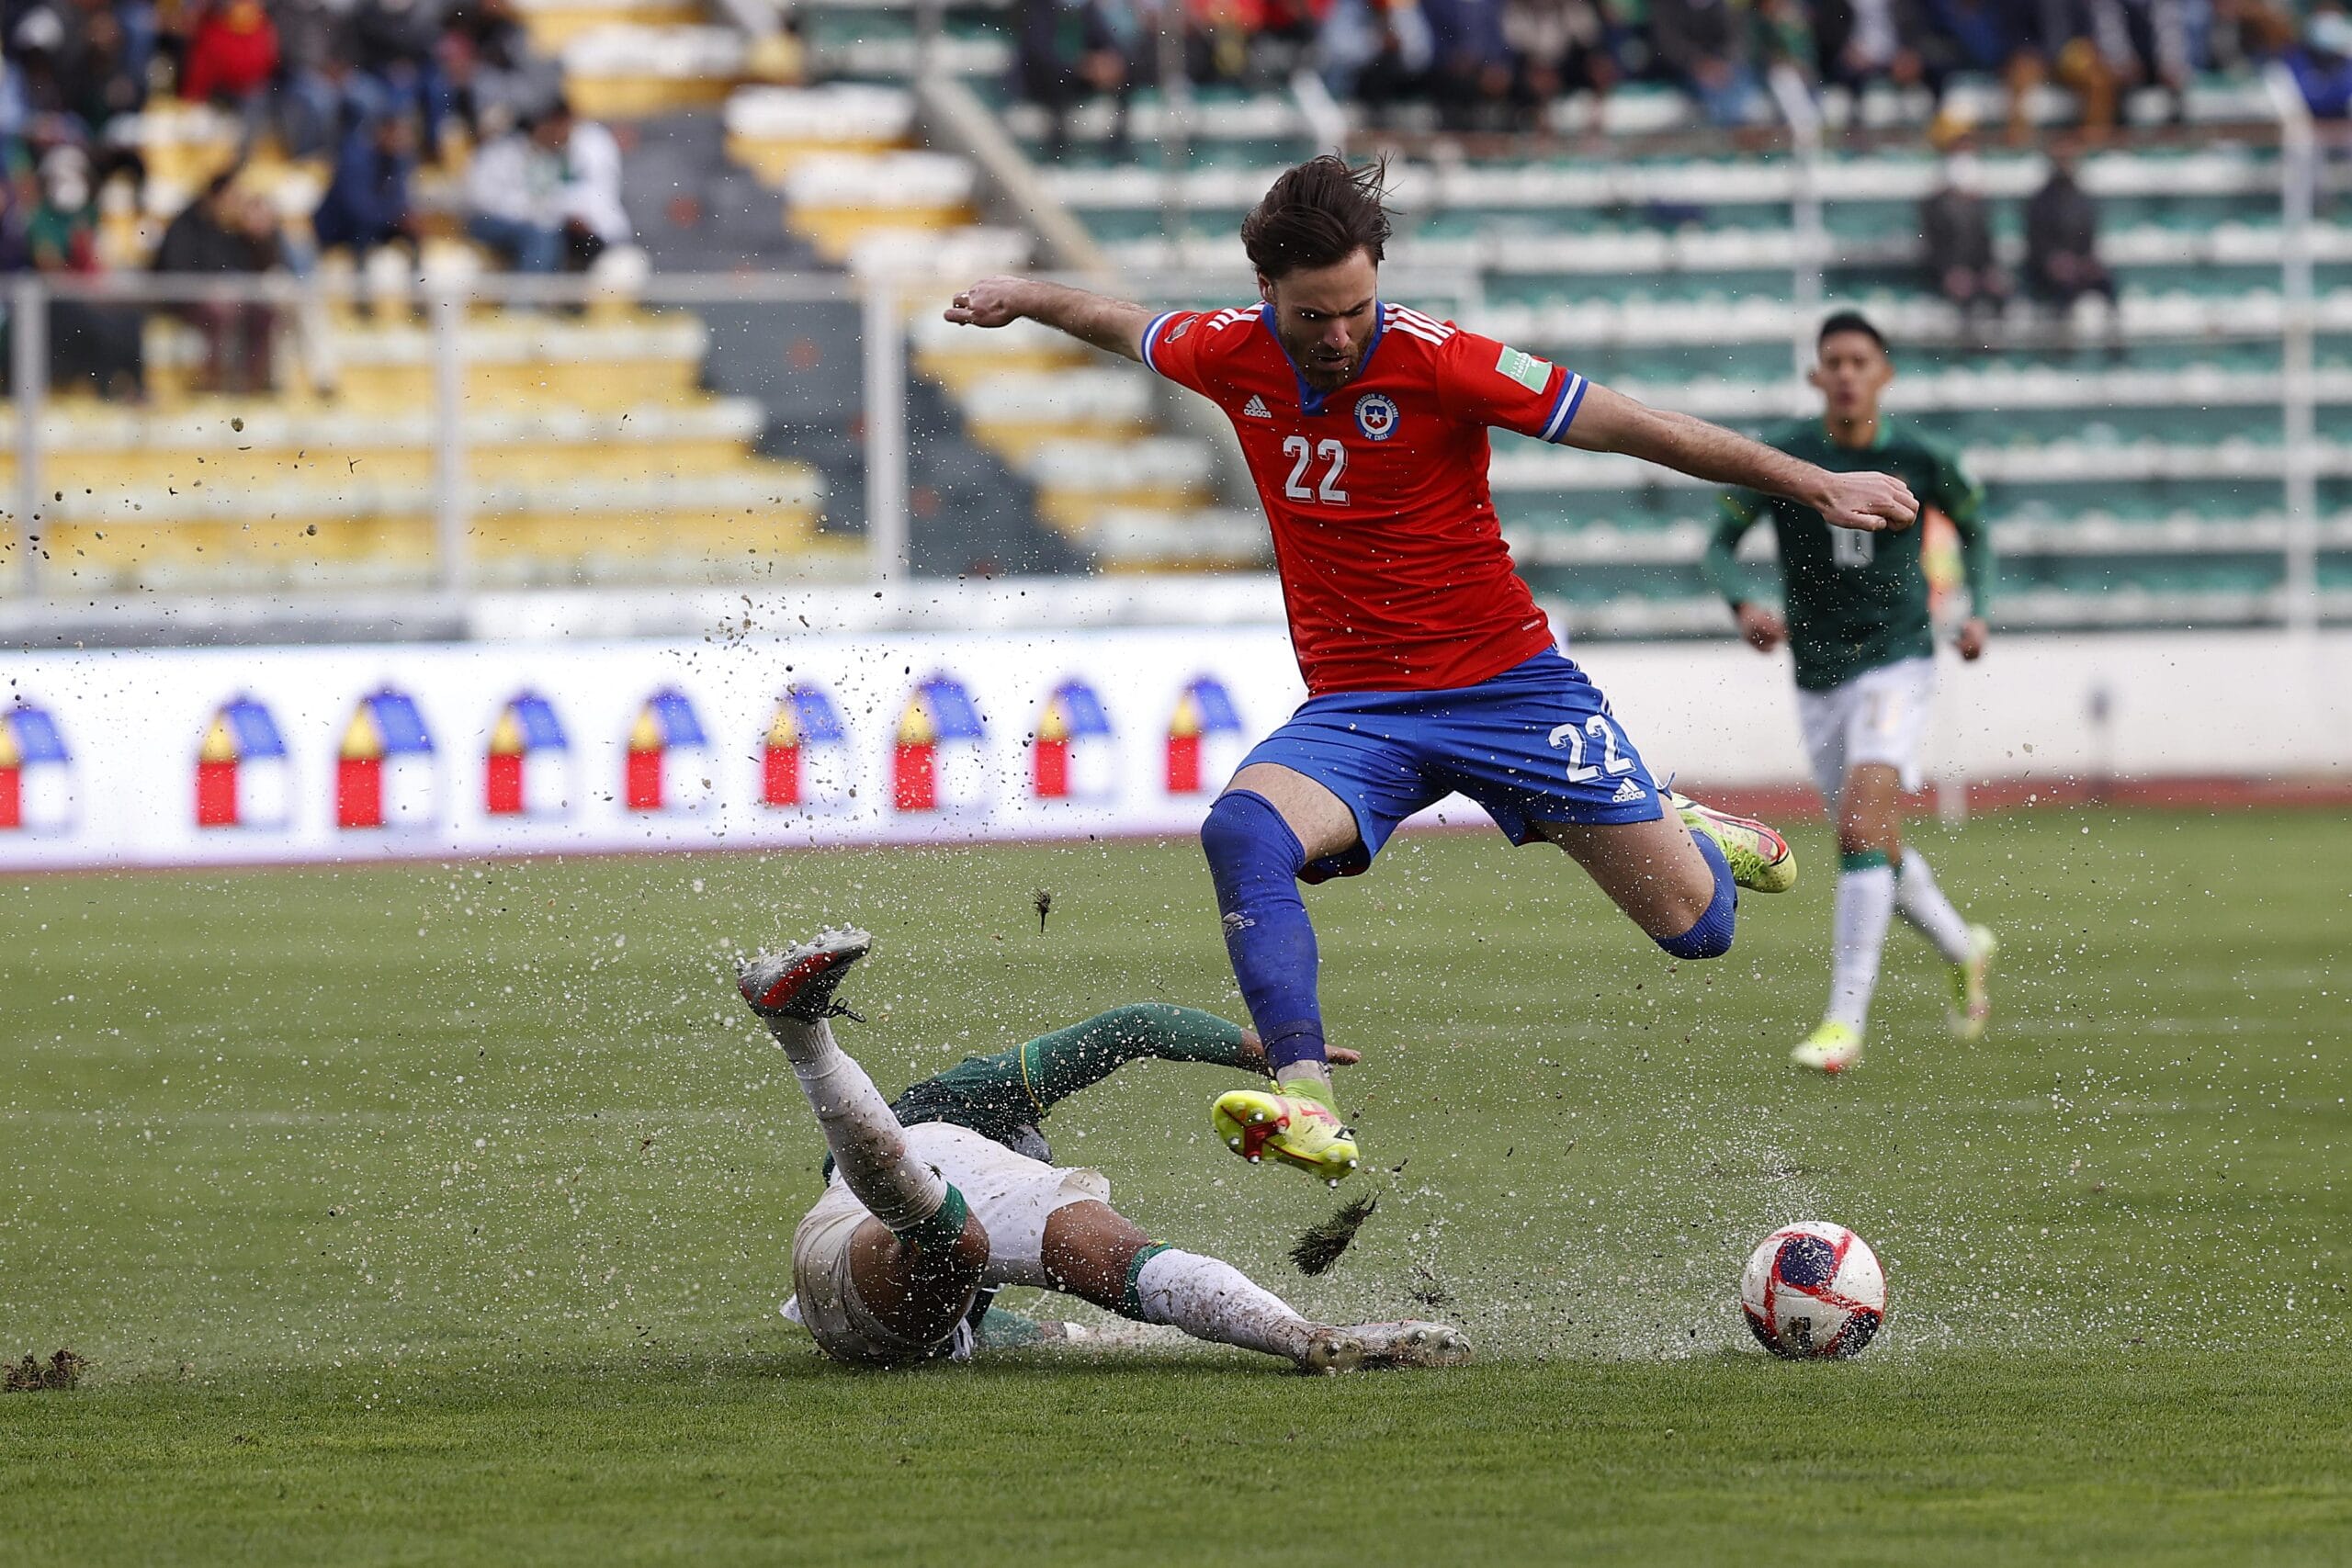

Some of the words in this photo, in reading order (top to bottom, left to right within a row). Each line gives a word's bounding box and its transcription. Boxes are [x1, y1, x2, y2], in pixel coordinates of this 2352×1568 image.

[1243, 408, 1272, 419] adidas
[1283, 435, 1351, 507] 22
[1548, 714, 1637, 784] 22
[1611, 789, 1646, 803] adidas
